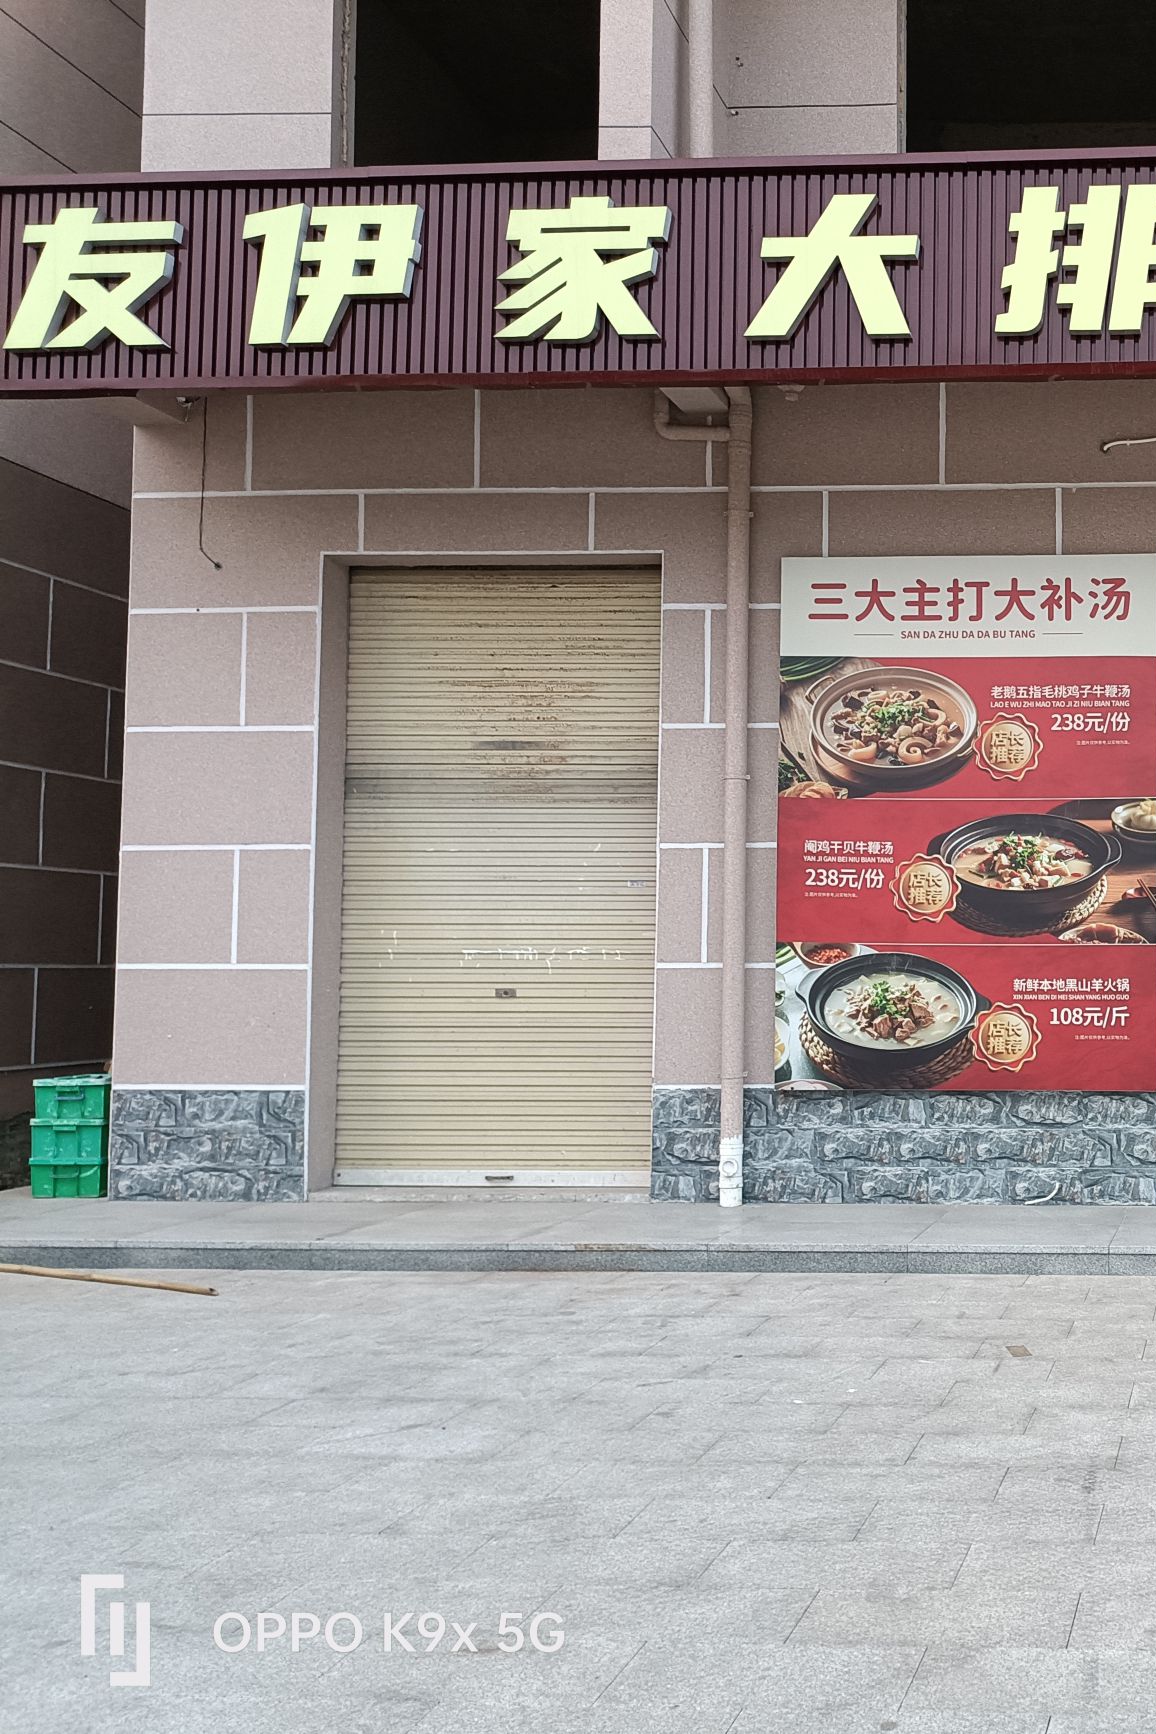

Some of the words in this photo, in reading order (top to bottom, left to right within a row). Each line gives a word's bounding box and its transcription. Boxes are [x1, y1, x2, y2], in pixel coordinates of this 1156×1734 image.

[807, 576, 1132, 622] 三大主打大补汤
[900, 631, 920, 639] SAN
[922, 631, 936, 639] DA
[938, 631, 959, 639] ZHU
[961, 631, 974, 639] DA
[977, 630, 990, 638] DA
[992, 630, 1006, 638] BU
[1009, 630, 1036, 638] TANG
[1050, 712, 1130, 733] 238元/份
[990, 730, 1025, 747] 店长
[990, 747, 1025, 764] 推荐
[804, 868, 885, 890] 238元/份
[908, 871, 943, 888] 店长
[908, 888, 943, 905] 推荐
[1013, 978, 1130, 992] 新鲜本地黑山羊火锅
[1049, 1006, 1130, 1028] 108元/斤
[987, 1020, 1023, 1037] 店长
[987, 1038, 1023, 1055] 推荐
